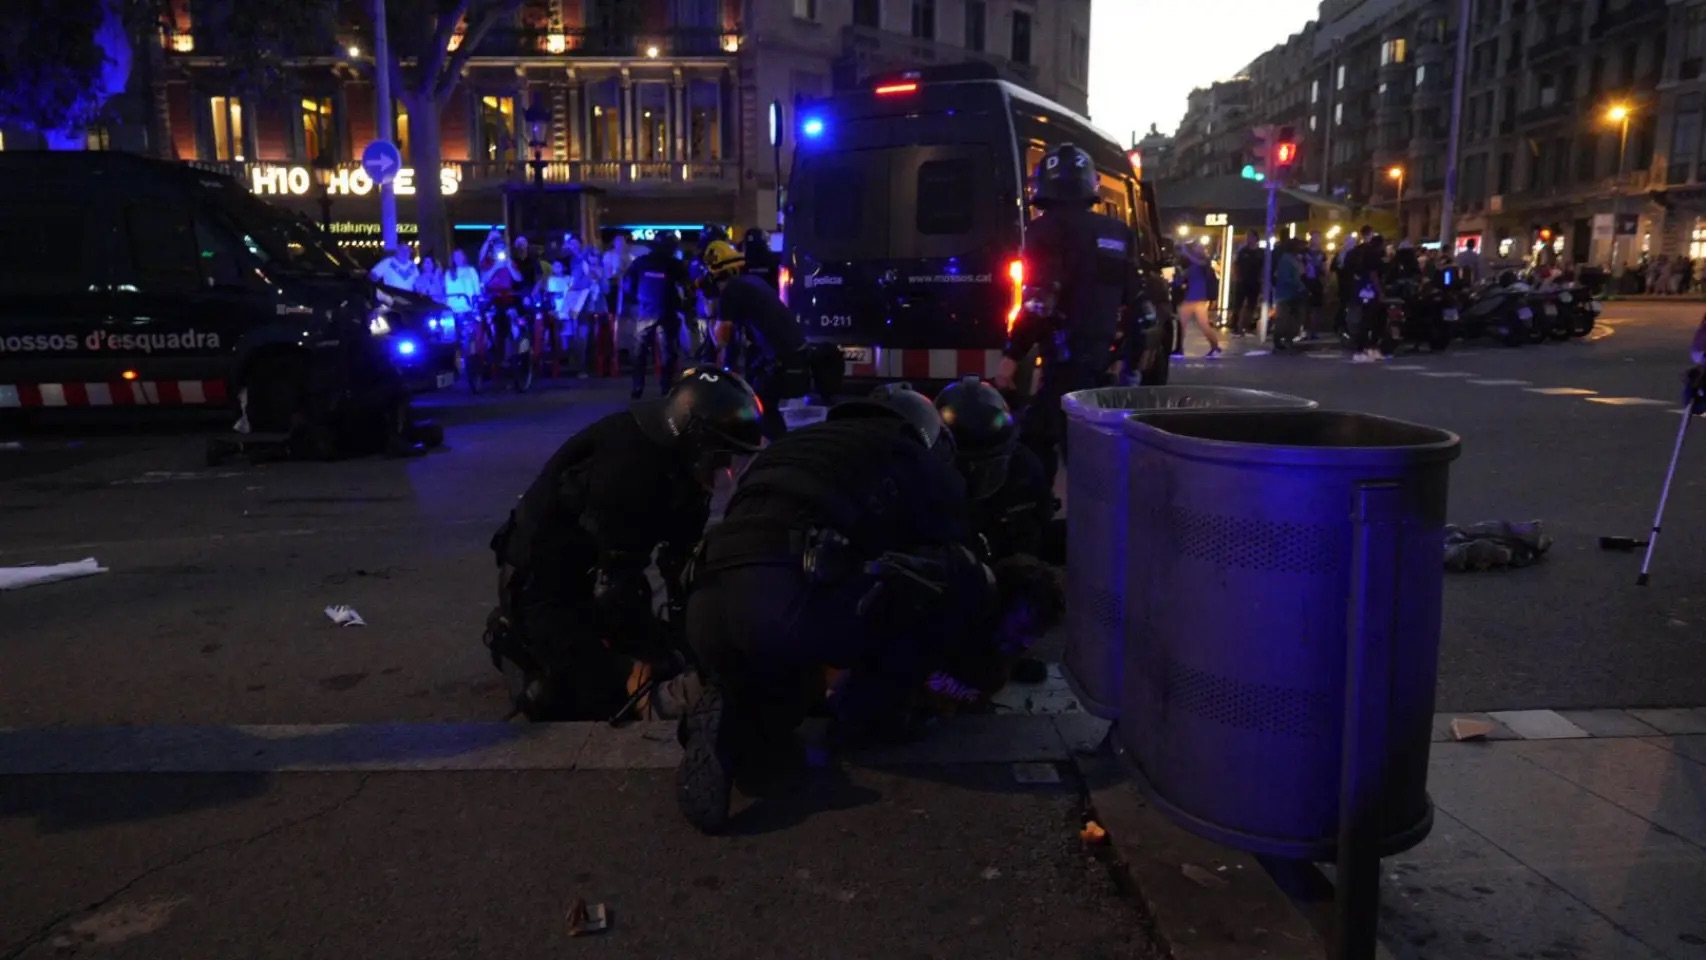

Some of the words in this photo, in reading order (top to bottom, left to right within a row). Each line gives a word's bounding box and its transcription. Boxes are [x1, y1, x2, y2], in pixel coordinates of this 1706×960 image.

[1046, 156, 1059, 170] D
[253, 167, 310, 195] H10
[327, 167, 460, 196] HOES
[820, 315, 852, 327] D-211
[85, 328, 220, 354] d'esquadra
